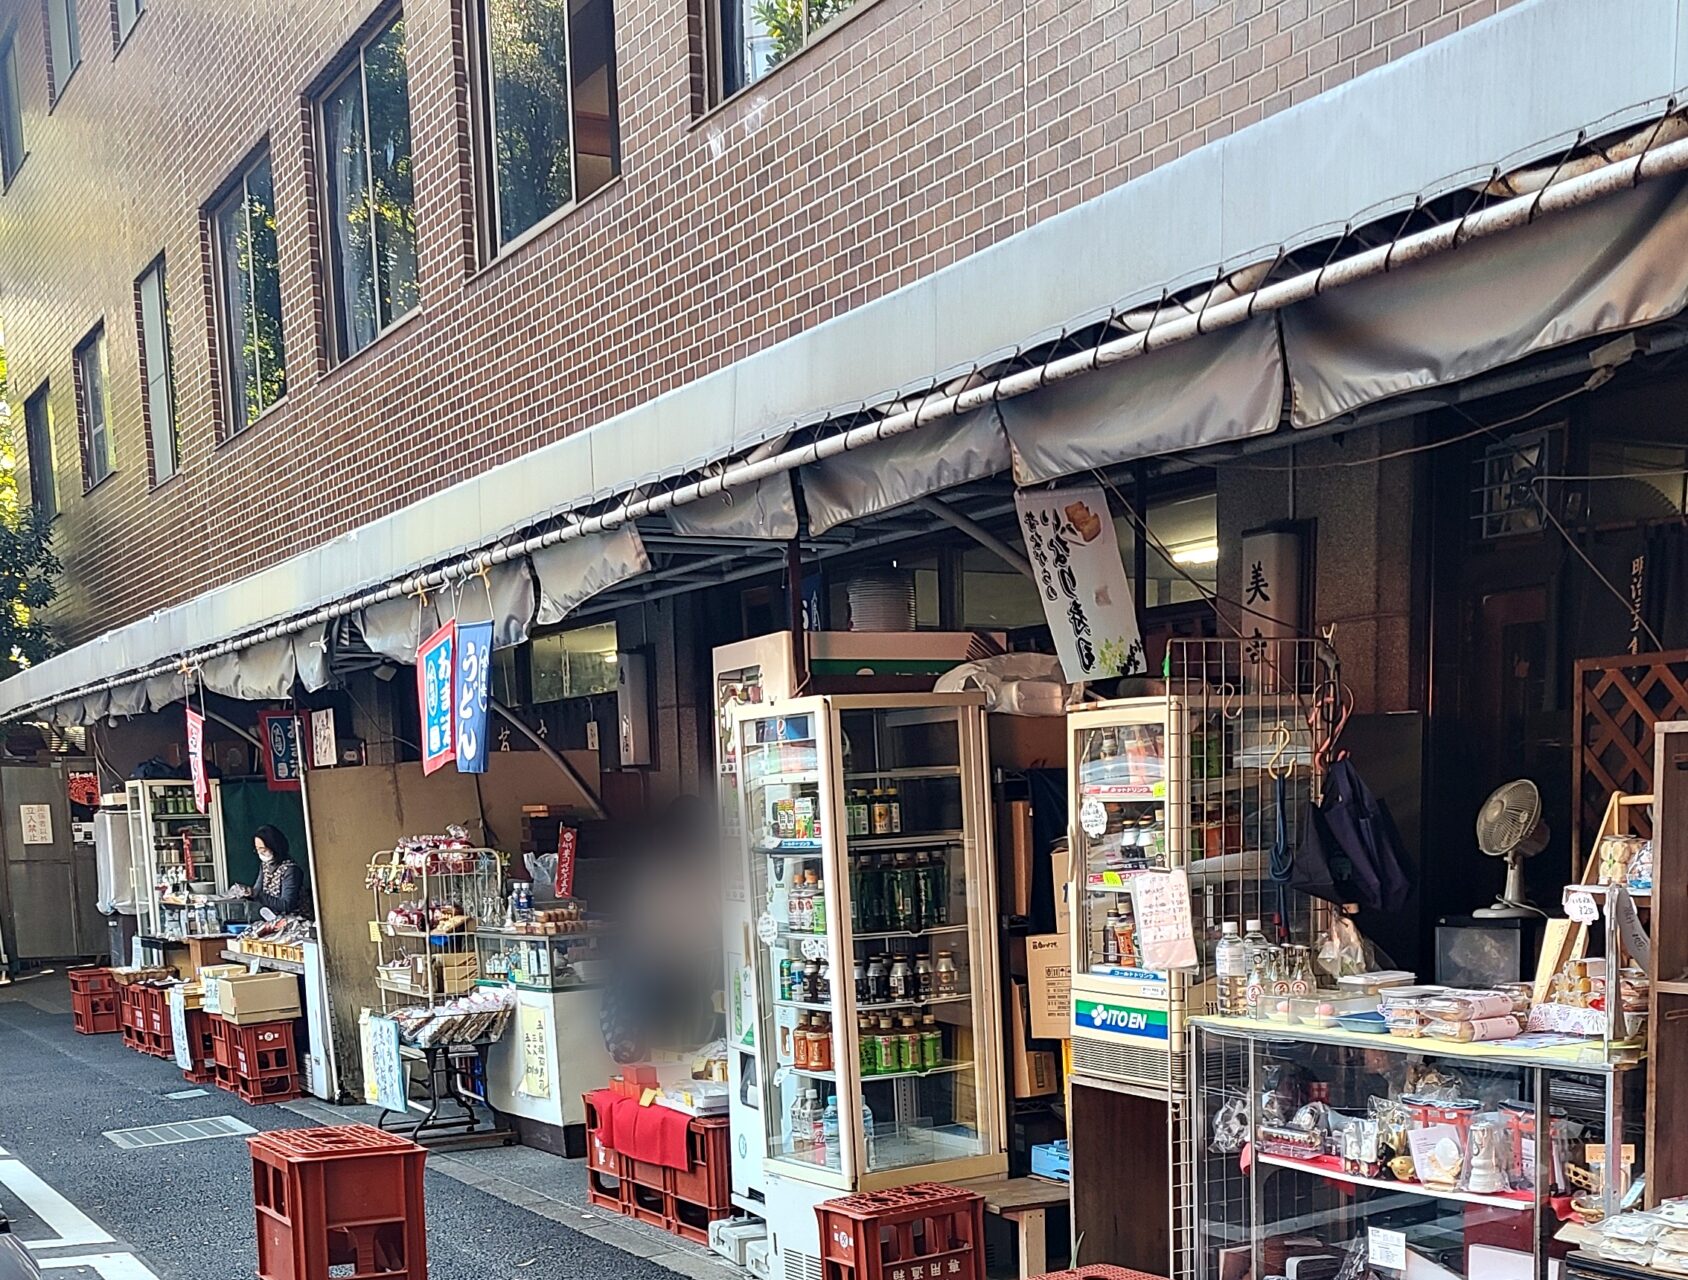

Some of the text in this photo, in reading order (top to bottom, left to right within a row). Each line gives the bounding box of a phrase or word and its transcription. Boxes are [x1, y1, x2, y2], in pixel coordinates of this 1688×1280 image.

[1039, 507, 1097, 675] いなり寿司
[456, 641, 478, 761] うどん
[25, 806, 39, 842] 立入禁止
[1106, 1009, 1147, 1031] ITO EN
